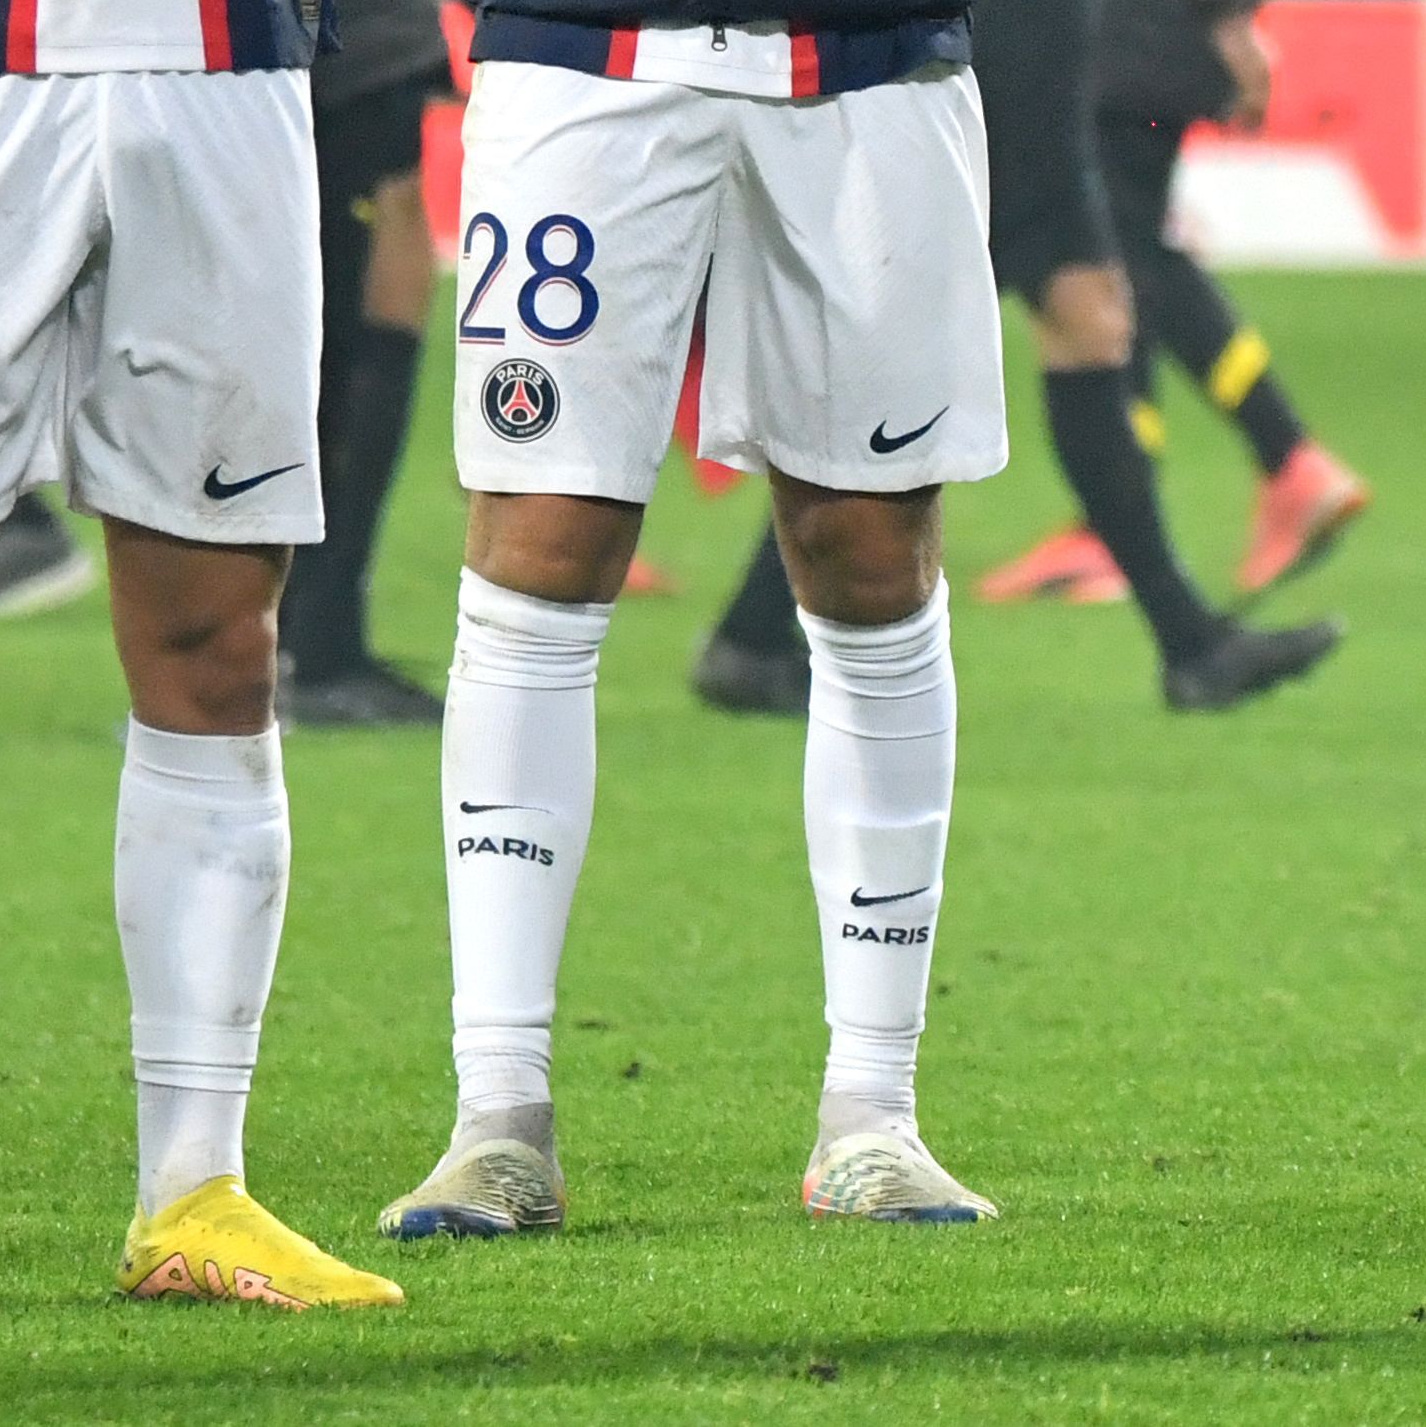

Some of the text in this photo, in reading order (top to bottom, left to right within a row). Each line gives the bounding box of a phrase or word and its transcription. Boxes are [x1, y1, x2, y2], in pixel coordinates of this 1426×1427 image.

[458, 211, 600, 347] 28
[495, 364, 545, 386] PARIS
[457, 836, 555, 867] PARIS
[842, 923, 929, 946] PARIS
